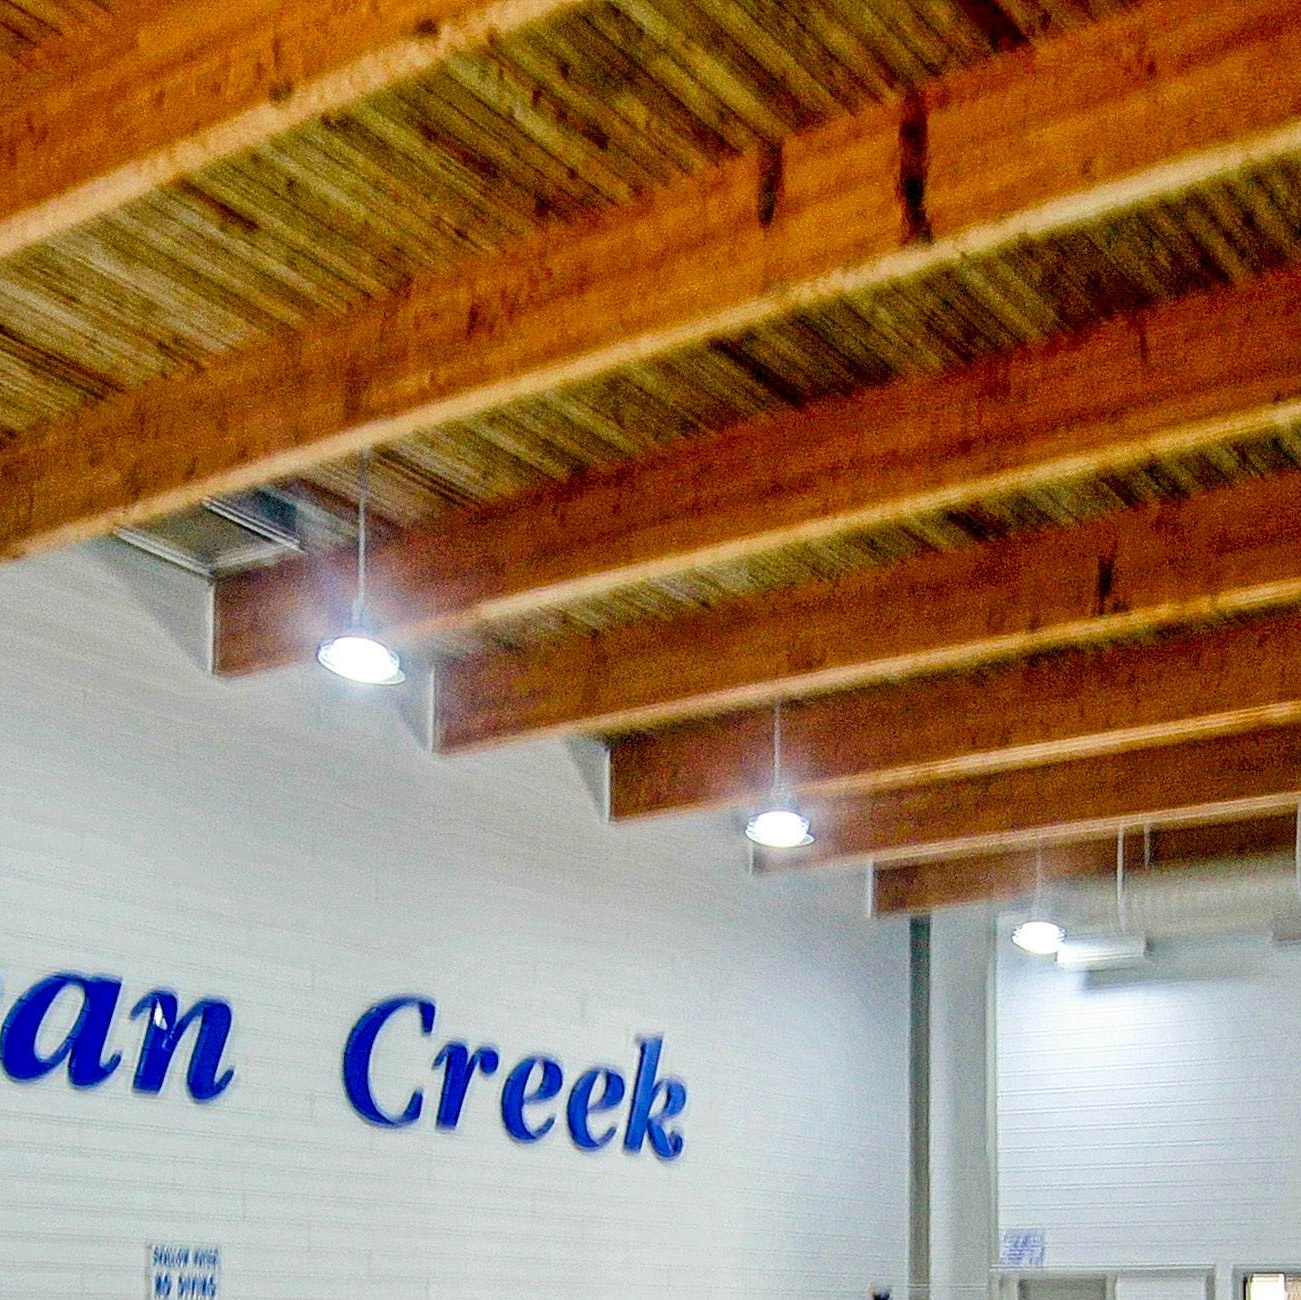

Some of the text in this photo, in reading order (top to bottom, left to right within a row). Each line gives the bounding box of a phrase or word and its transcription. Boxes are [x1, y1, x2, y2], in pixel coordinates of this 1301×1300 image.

[343, 998, 686, 1158] Creek
[154, 1273, 217, 1300] NO DIVING
